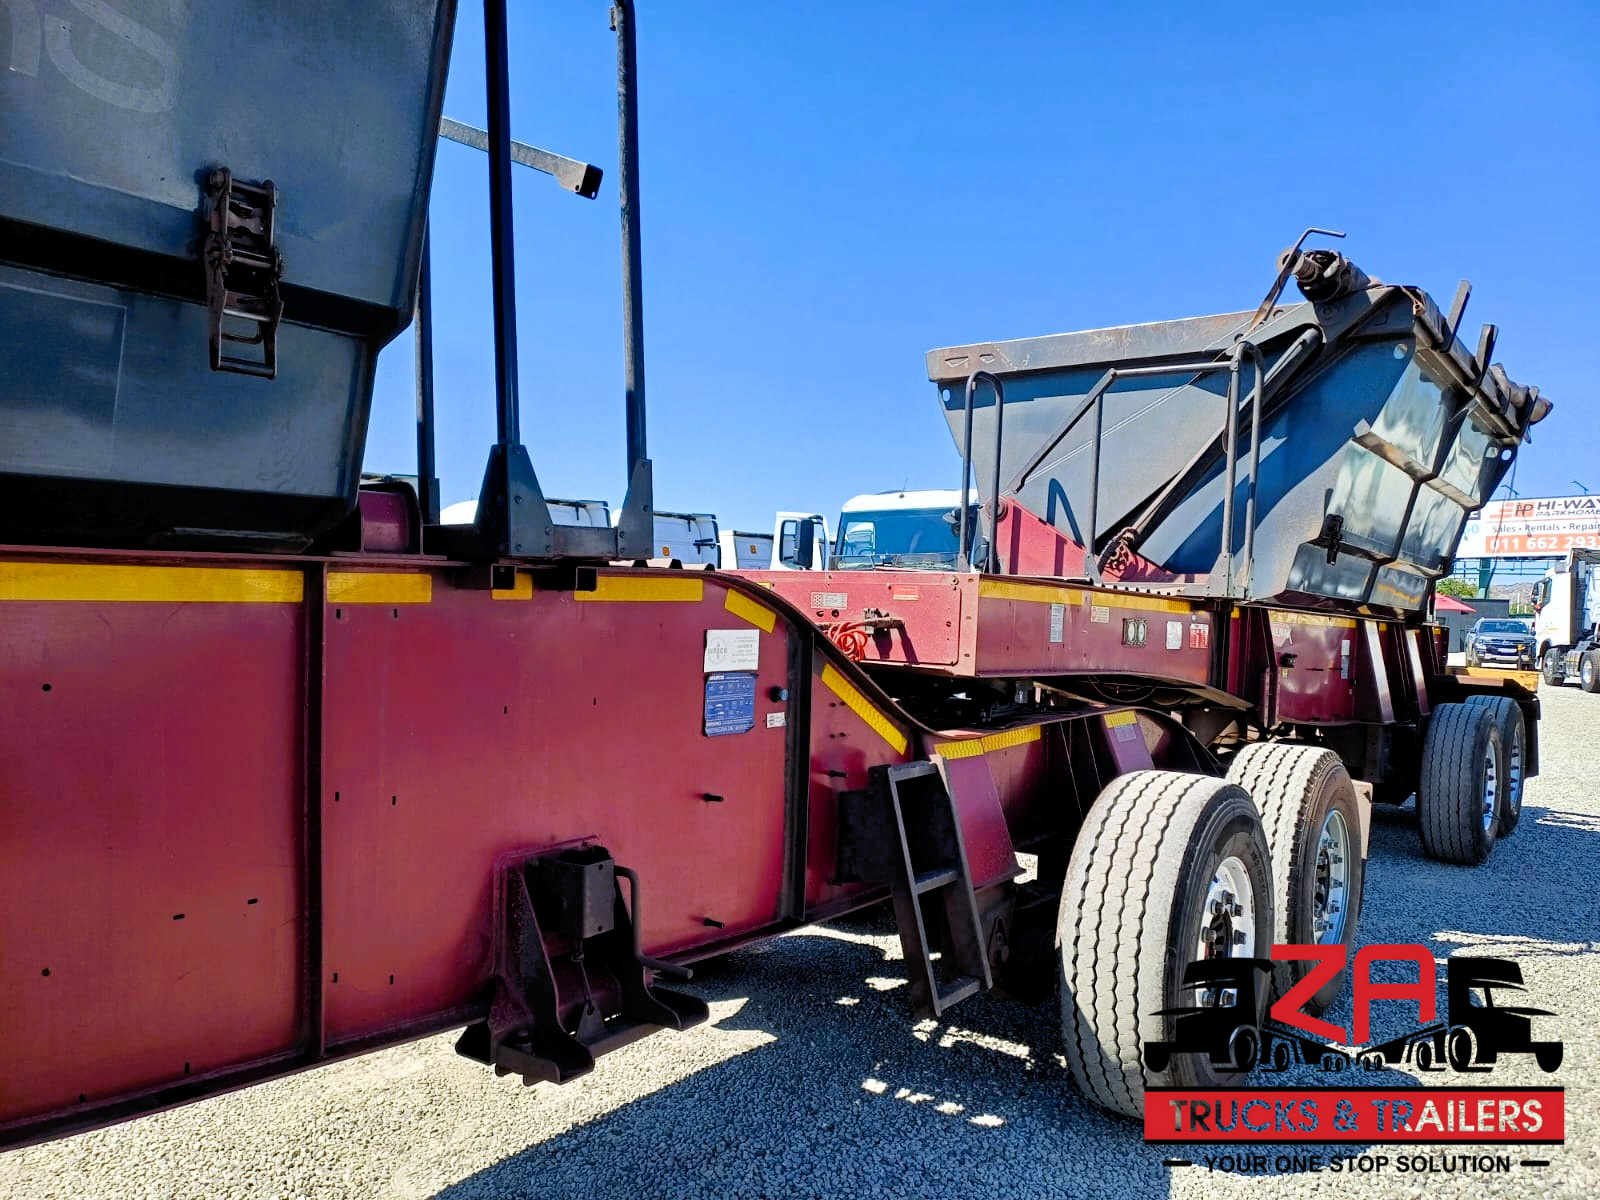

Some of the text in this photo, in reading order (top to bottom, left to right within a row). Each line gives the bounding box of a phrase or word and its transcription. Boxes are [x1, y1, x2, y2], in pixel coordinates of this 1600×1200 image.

[1492, 525, 1516, 533] Sales
[1525, 523, 1560, 533] Rentals
[1490, 535, 1600, 551] 011 662 293
